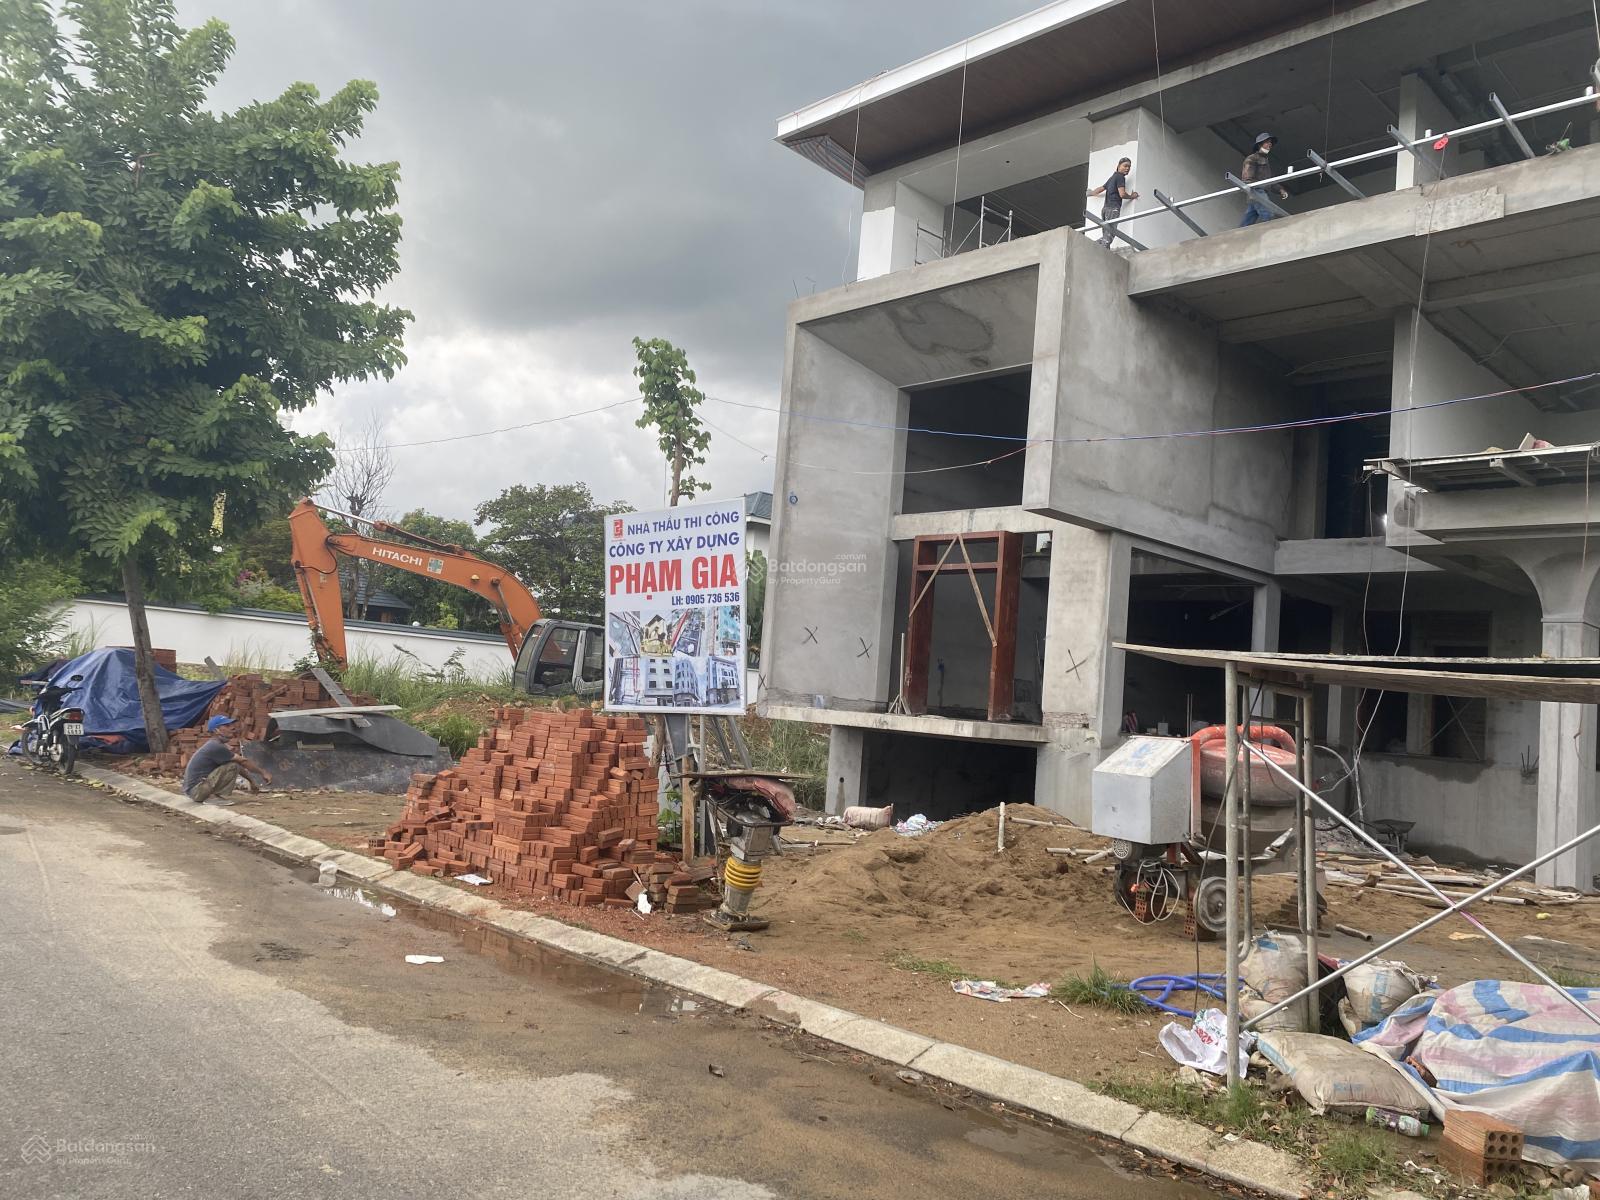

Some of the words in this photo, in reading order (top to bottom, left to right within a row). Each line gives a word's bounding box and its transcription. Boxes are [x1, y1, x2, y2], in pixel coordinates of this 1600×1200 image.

[627, 521, 650, 535] NHÀ
[684, 515, 702, 529] THI
[705, 511, 740, 526] CÔNG
[609, 542, 645, 557] CÔNG
[649, 540, 664, 553] TY
[666, 535, 693, 552] XÂY
[696, 531, 740, 551] DỰNG
[372, 547, 423, 566] HITACHI
[610, 559, 682, 600] PHẠM
[691, 553, 739, 590] GIA
[671, 595, 684, 606] LH:
[685, 594, 705, 605] 0905
[707, 593, 722, 604] 736
[724, 591, 740, 603] 536
